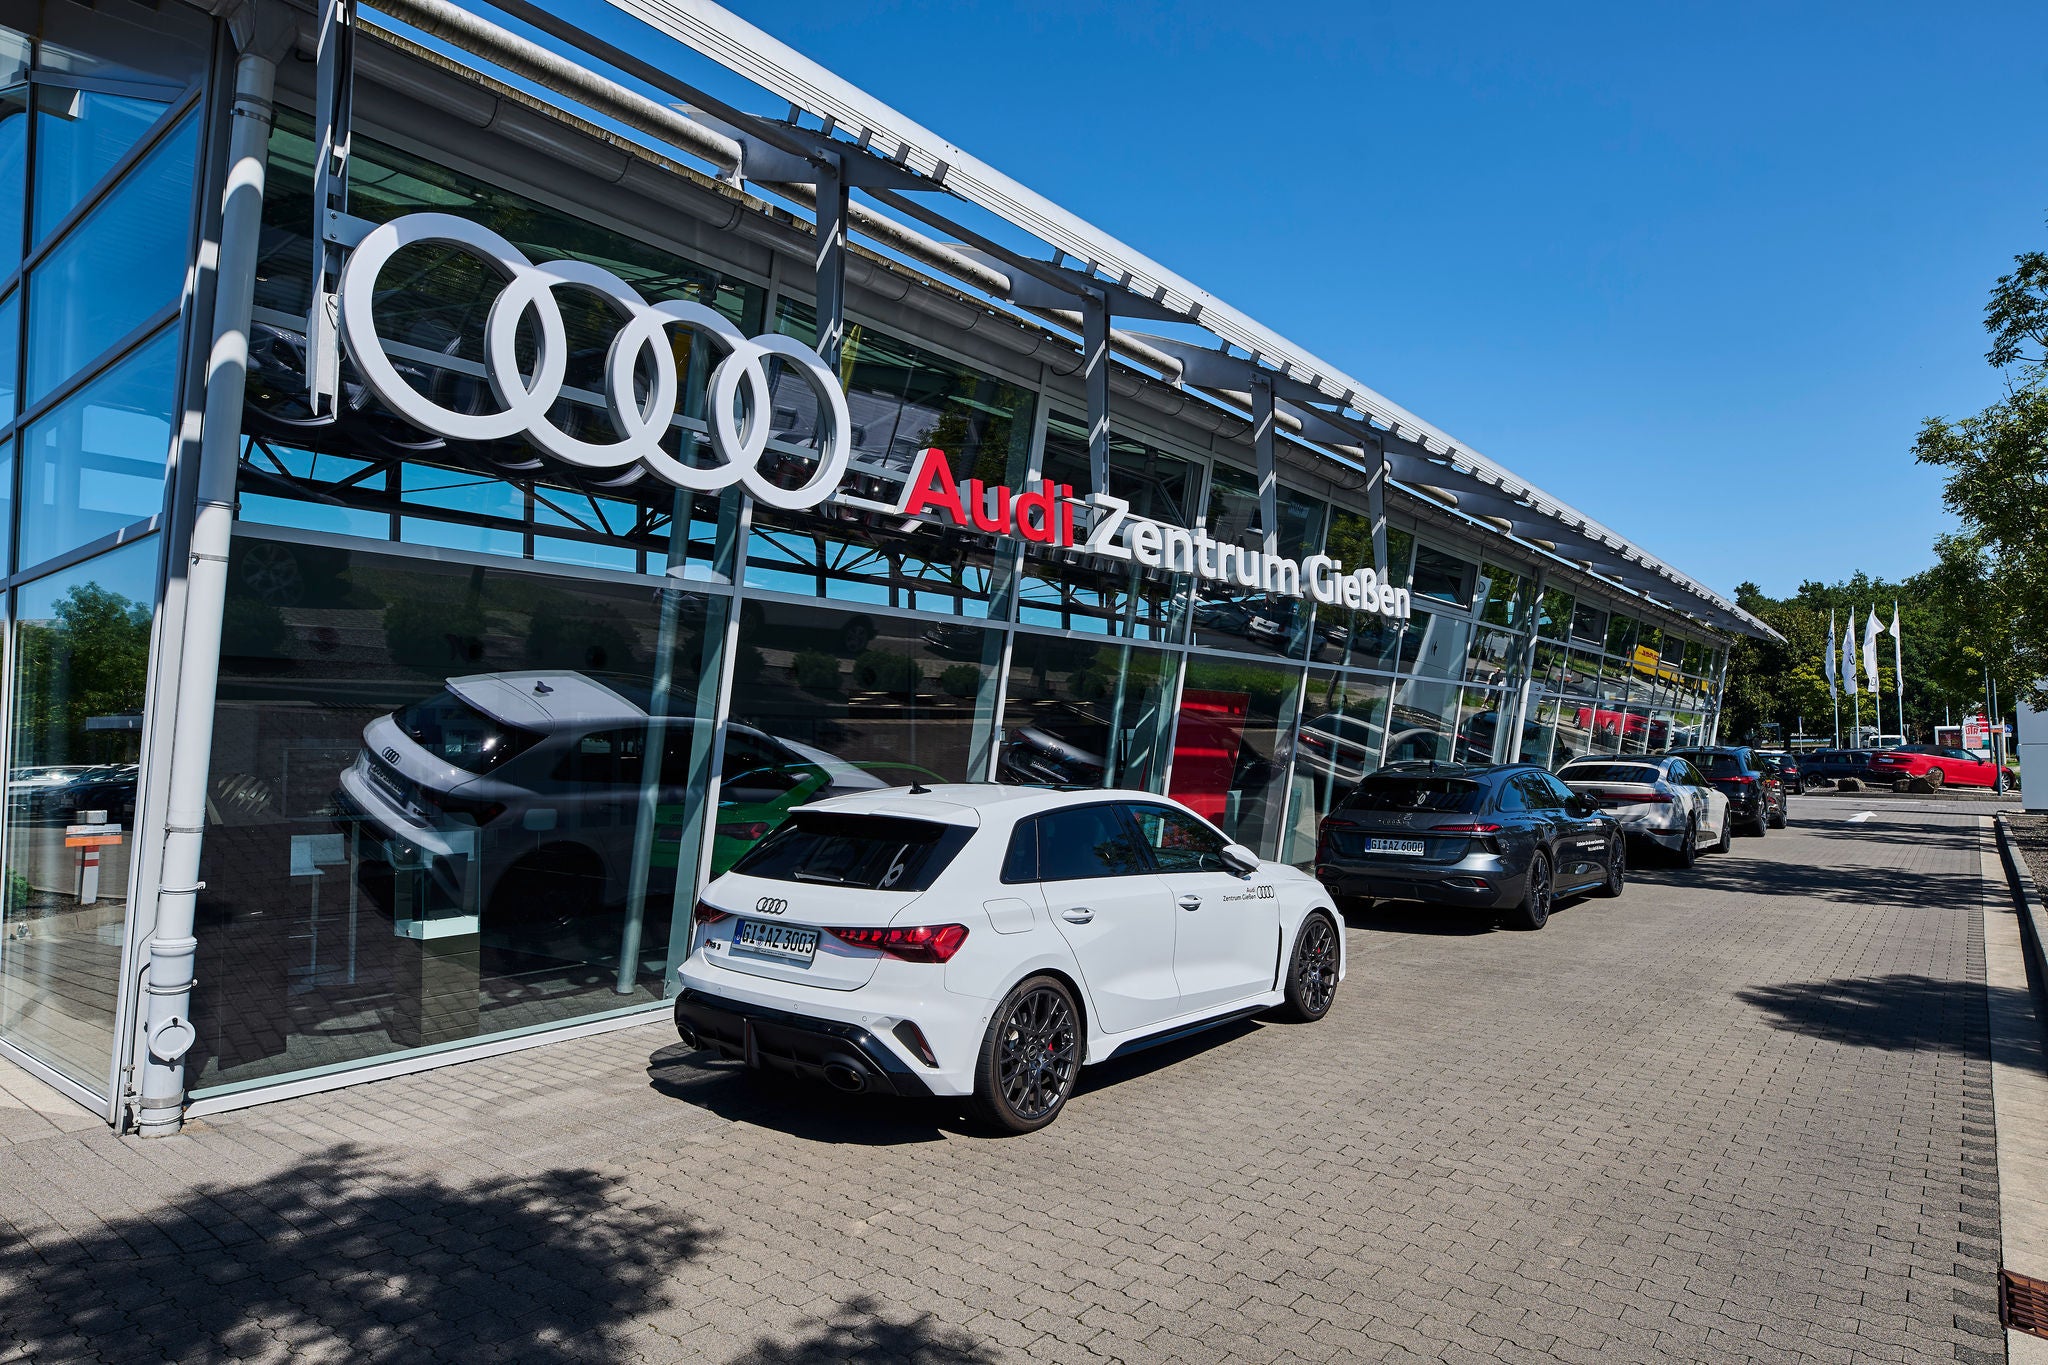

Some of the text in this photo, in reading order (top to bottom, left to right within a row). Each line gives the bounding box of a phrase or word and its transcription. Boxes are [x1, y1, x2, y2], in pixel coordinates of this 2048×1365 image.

[898, 446, 1411, 619] Audi Zentrum Gießen
[1371, 839, 1423, 852] GI AZ 6000
[742, 924, 757, 944] GI
[764, 928, 782, 949] AZ
[783, 931, 815, 954] 3003
